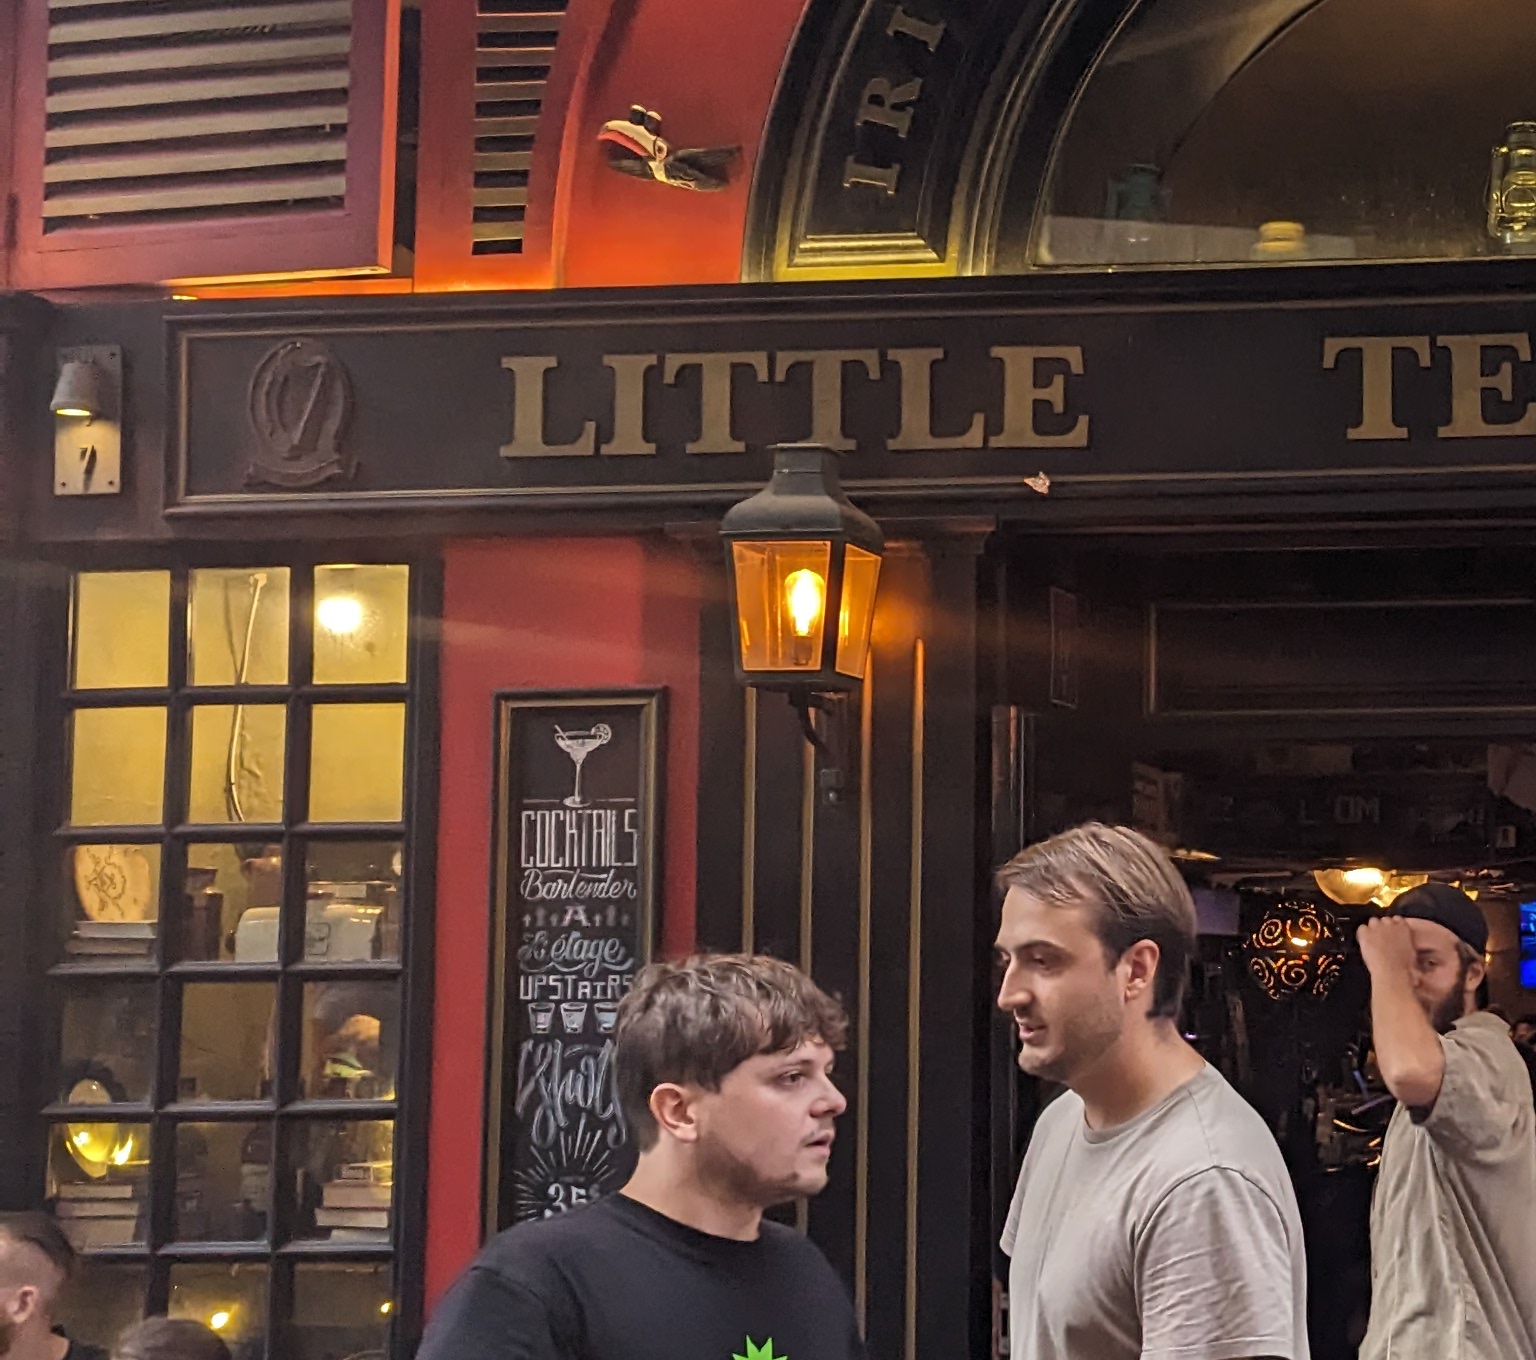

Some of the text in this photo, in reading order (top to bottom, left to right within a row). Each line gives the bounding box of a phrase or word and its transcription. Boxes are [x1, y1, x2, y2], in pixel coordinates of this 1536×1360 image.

[499, 343, 1091, 460] LITTLE
[520, 809, 638, 868] COCKTAILS
[520, 868, 637, 900] Bartender
[562, 904, 591, 927] A
